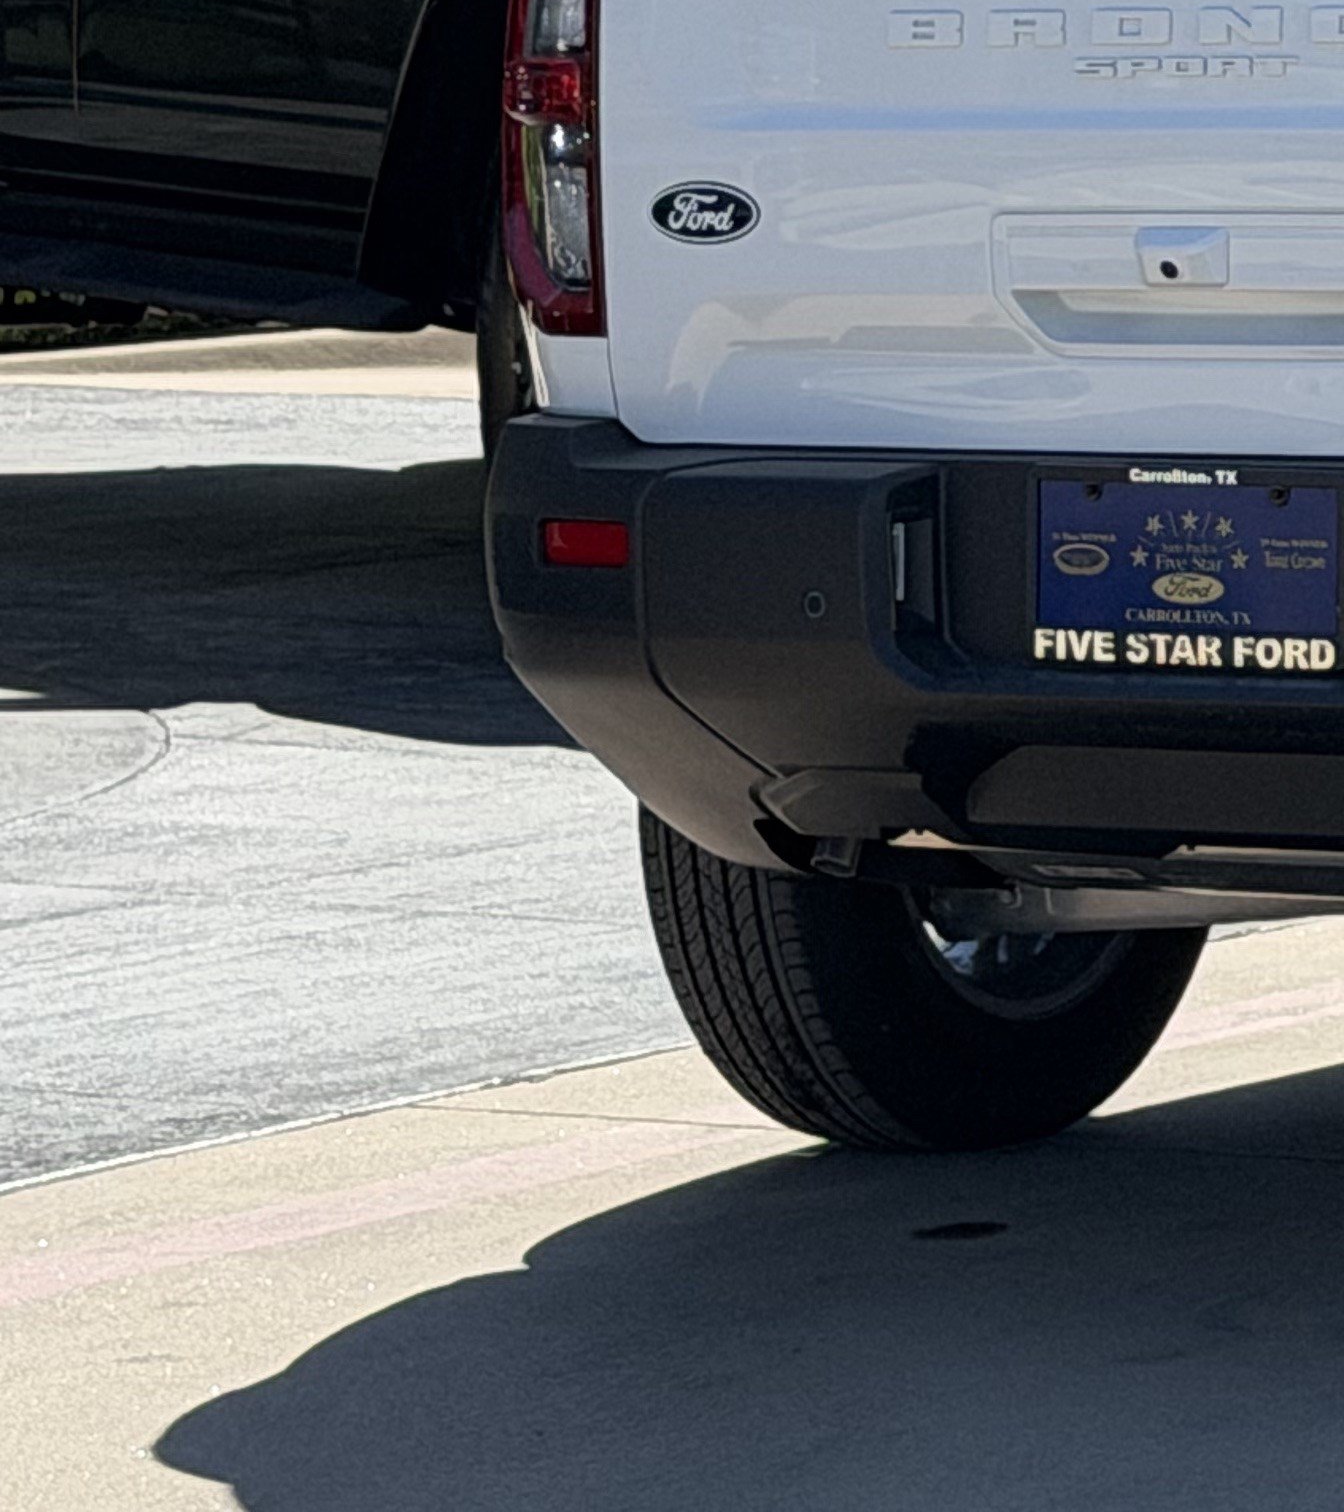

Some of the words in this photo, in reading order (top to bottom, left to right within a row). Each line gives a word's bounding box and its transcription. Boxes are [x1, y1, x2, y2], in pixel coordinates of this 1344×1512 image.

[1073, 55, 1300, 79] SPORT
[667, 192, 736, 231] Ford
[1215, 469, 1238, 485] TX
[1155, 553, 1188, 571] Five
[1192, 555, 1224, 572] Star
[1164, 575, 1213, 598] Ford
[1232, 610, 1251, 625] TX
[1034, 628, 1116, 662] FIVE
[1125, 633, 1223, 668] STAR
[1232, 636, 1336, 670] FORD
